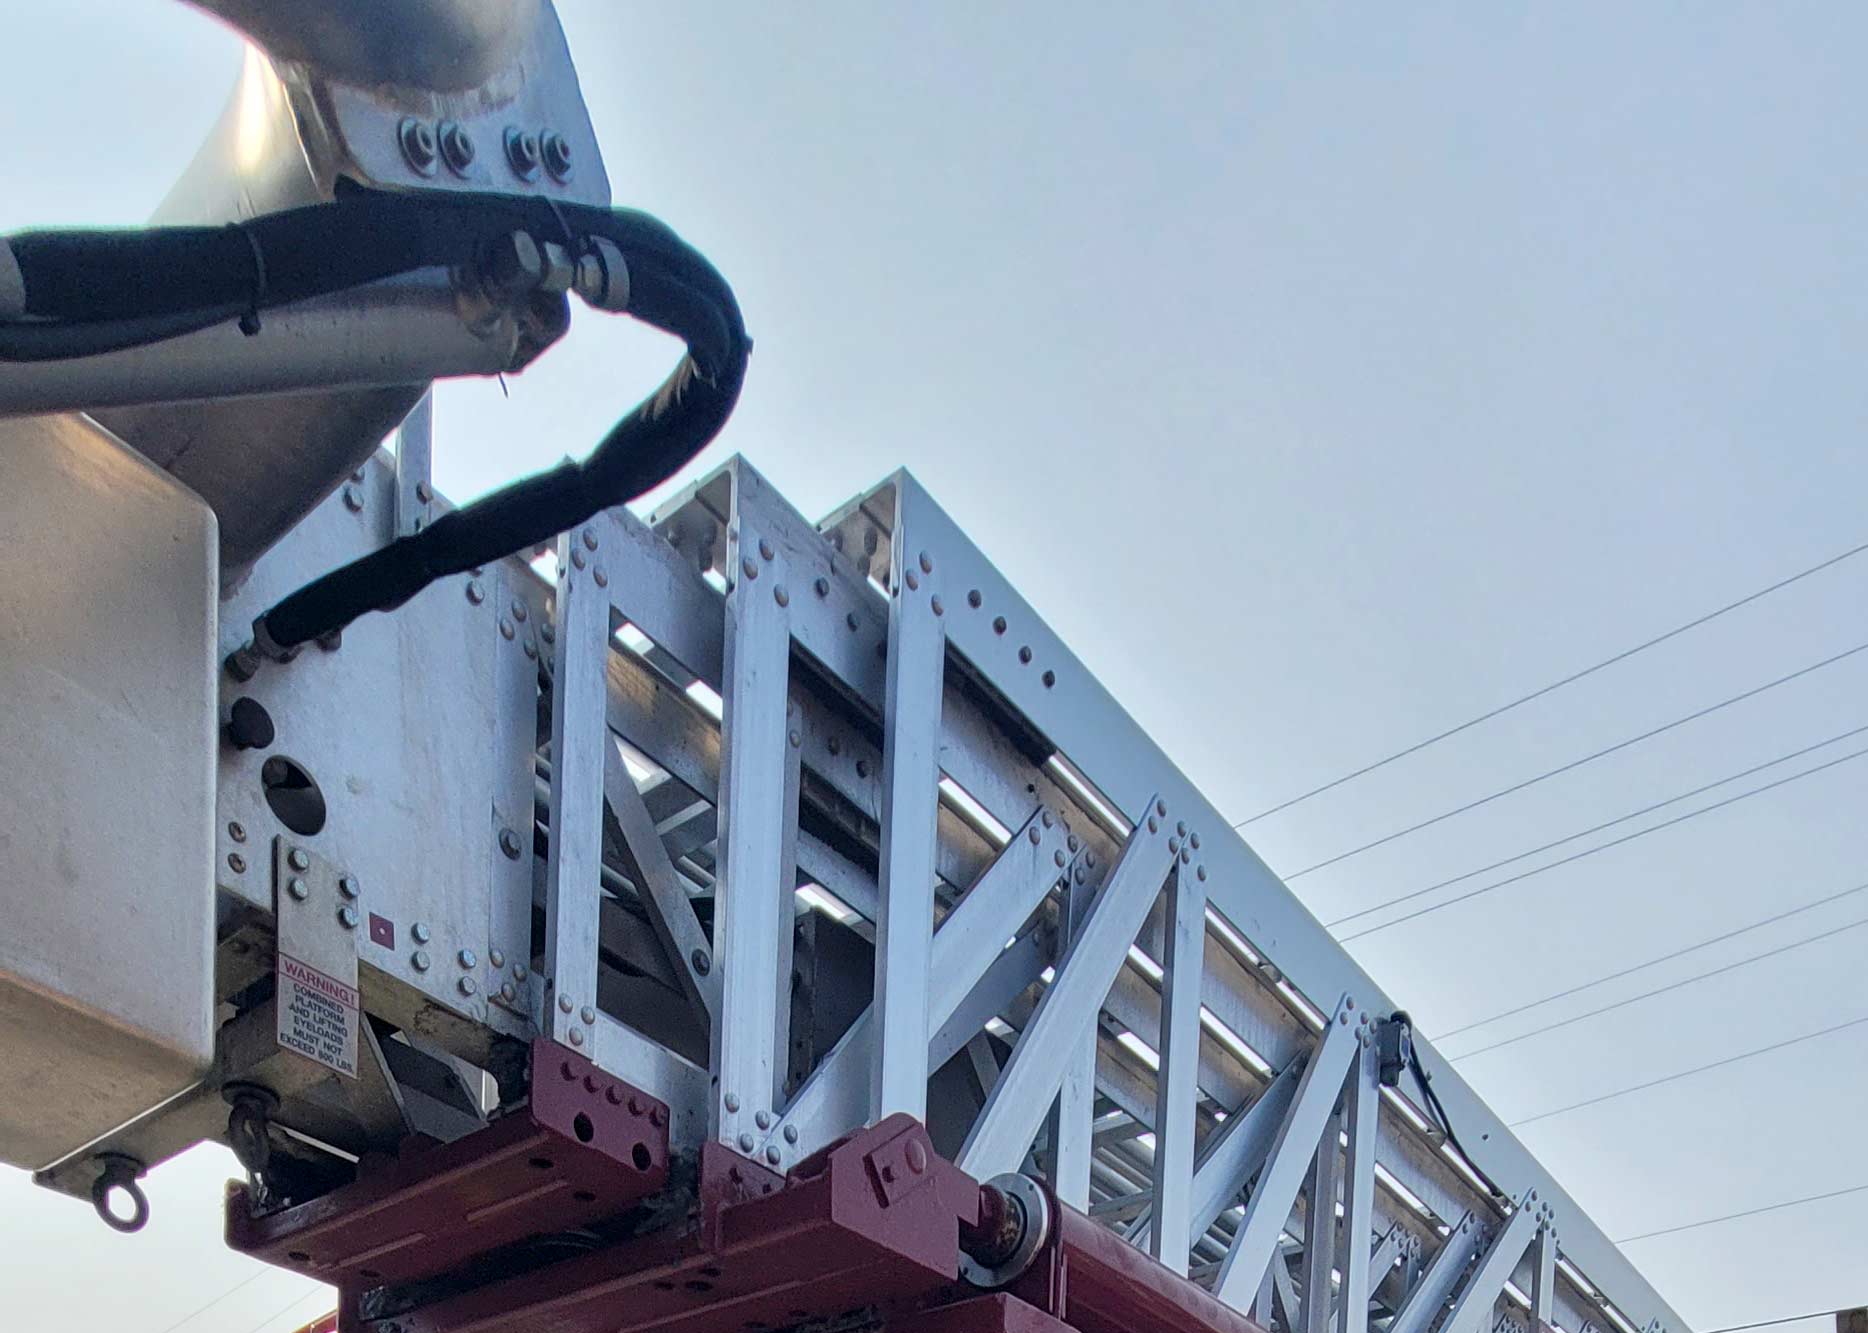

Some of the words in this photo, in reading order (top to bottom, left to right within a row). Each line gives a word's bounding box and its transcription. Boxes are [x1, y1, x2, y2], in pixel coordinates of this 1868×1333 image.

[284, 960, 355, 1005] WARNING!
[293, 983, 344, 1014] COMBINED
[295, 995, 345, 1025] PLATFORM
[289, 1003, 310, 1018] AND
[313, 1013, 348, 1038] LIFTING
[280, 1033, 315, 1055] EXCEED
[293, 1027, 320, 1046] MUST
[323, 1041, 342, 1056] NOT
